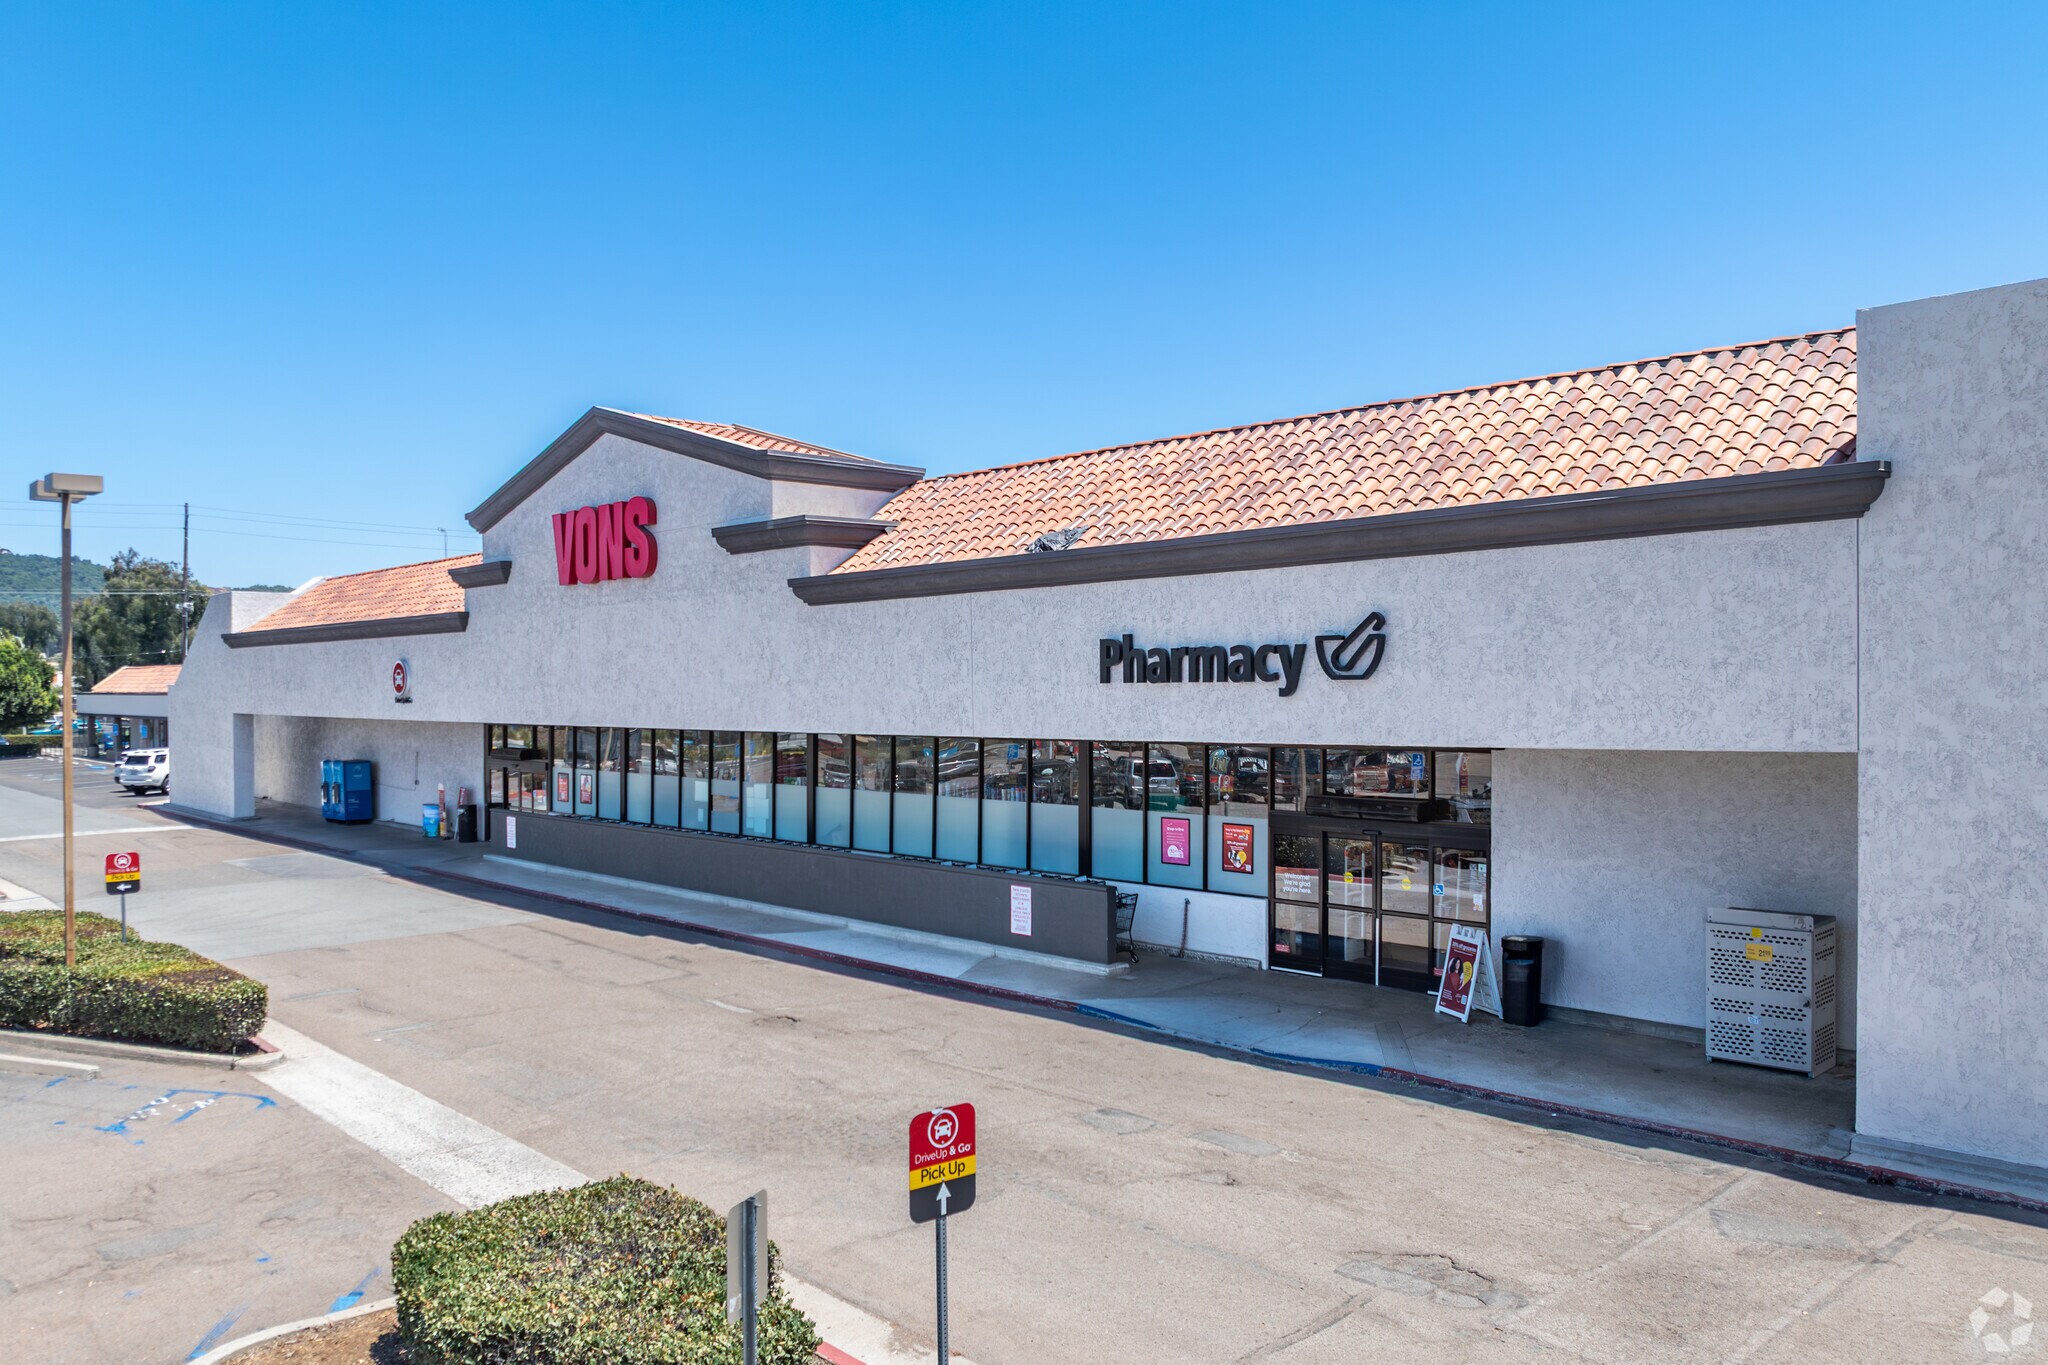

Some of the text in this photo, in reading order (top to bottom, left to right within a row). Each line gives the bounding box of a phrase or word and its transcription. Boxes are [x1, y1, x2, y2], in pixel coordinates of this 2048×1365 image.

[552, 496, 658, 586] VONS
[1099, 633, 1307, 697] Pharmacy
[1284, 872, 1311, 880] Welcome!
[914, 1142, 971, 1165] DriveUp & Go
[920, 1161, 966, 1183] Pick Up
